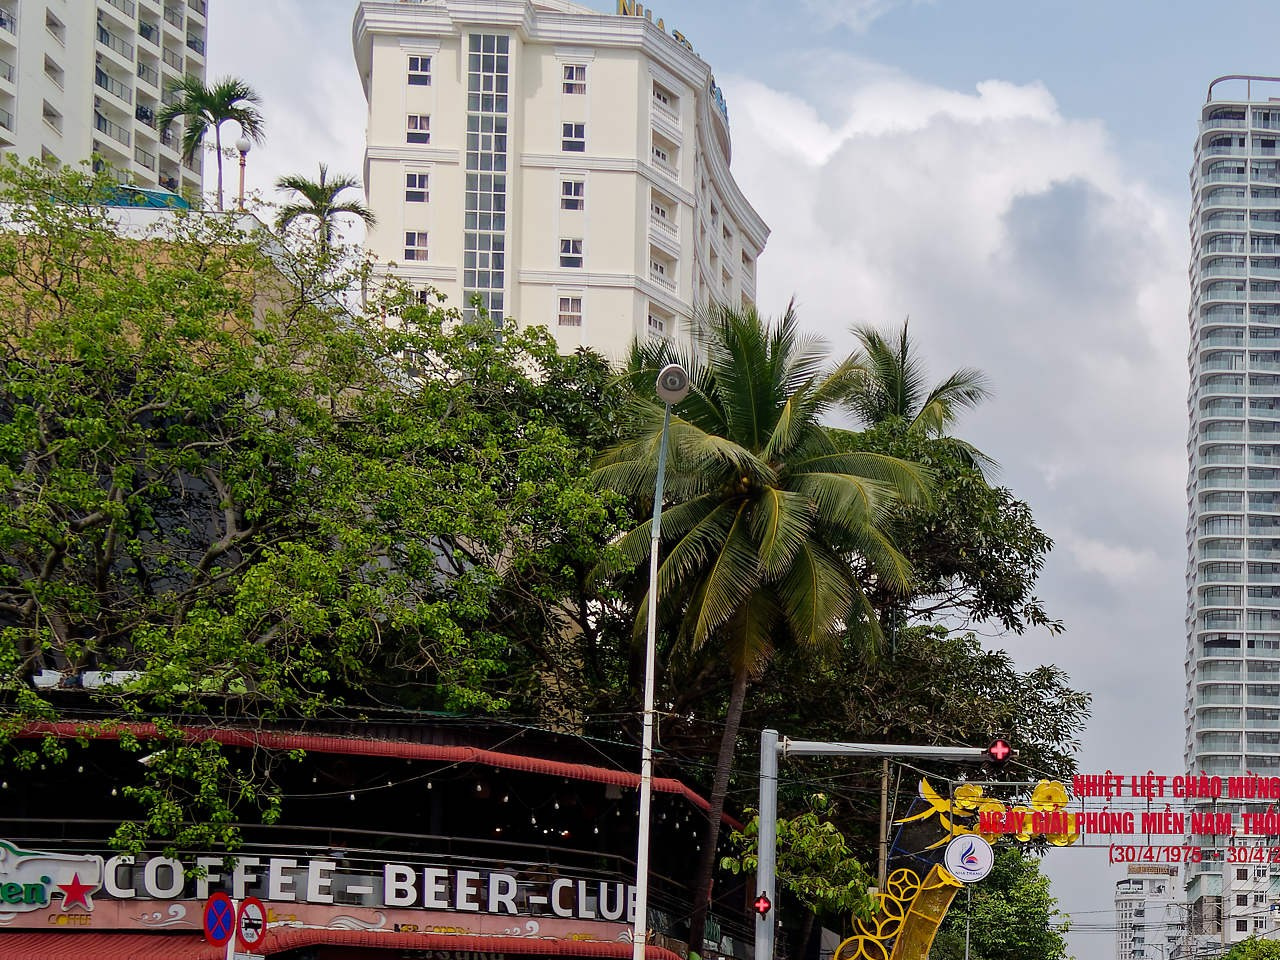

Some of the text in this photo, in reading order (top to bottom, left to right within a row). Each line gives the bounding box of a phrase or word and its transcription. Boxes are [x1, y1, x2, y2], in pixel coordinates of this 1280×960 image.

[1073, 770, 1124, 801] NHIỆT
[1131, 770, 1167, 801] LIỆT
[1173, 770, 1222, 798] CHÀO
[1228, 770, 1280, 799] MỪNG
[979, 805, 1026, 834] NGÀY
[1031, 803, 1068, 834] GIẢI
[1074, 805, 1135, 834] PHÓNG
[1141, 803, 1185, 834] MIỀN
[1191, 812, 1236, 838] NAM,
[1109, 843, 1202, 864] (30/4/1975
[48, 913, 91, 926] COFFEE
